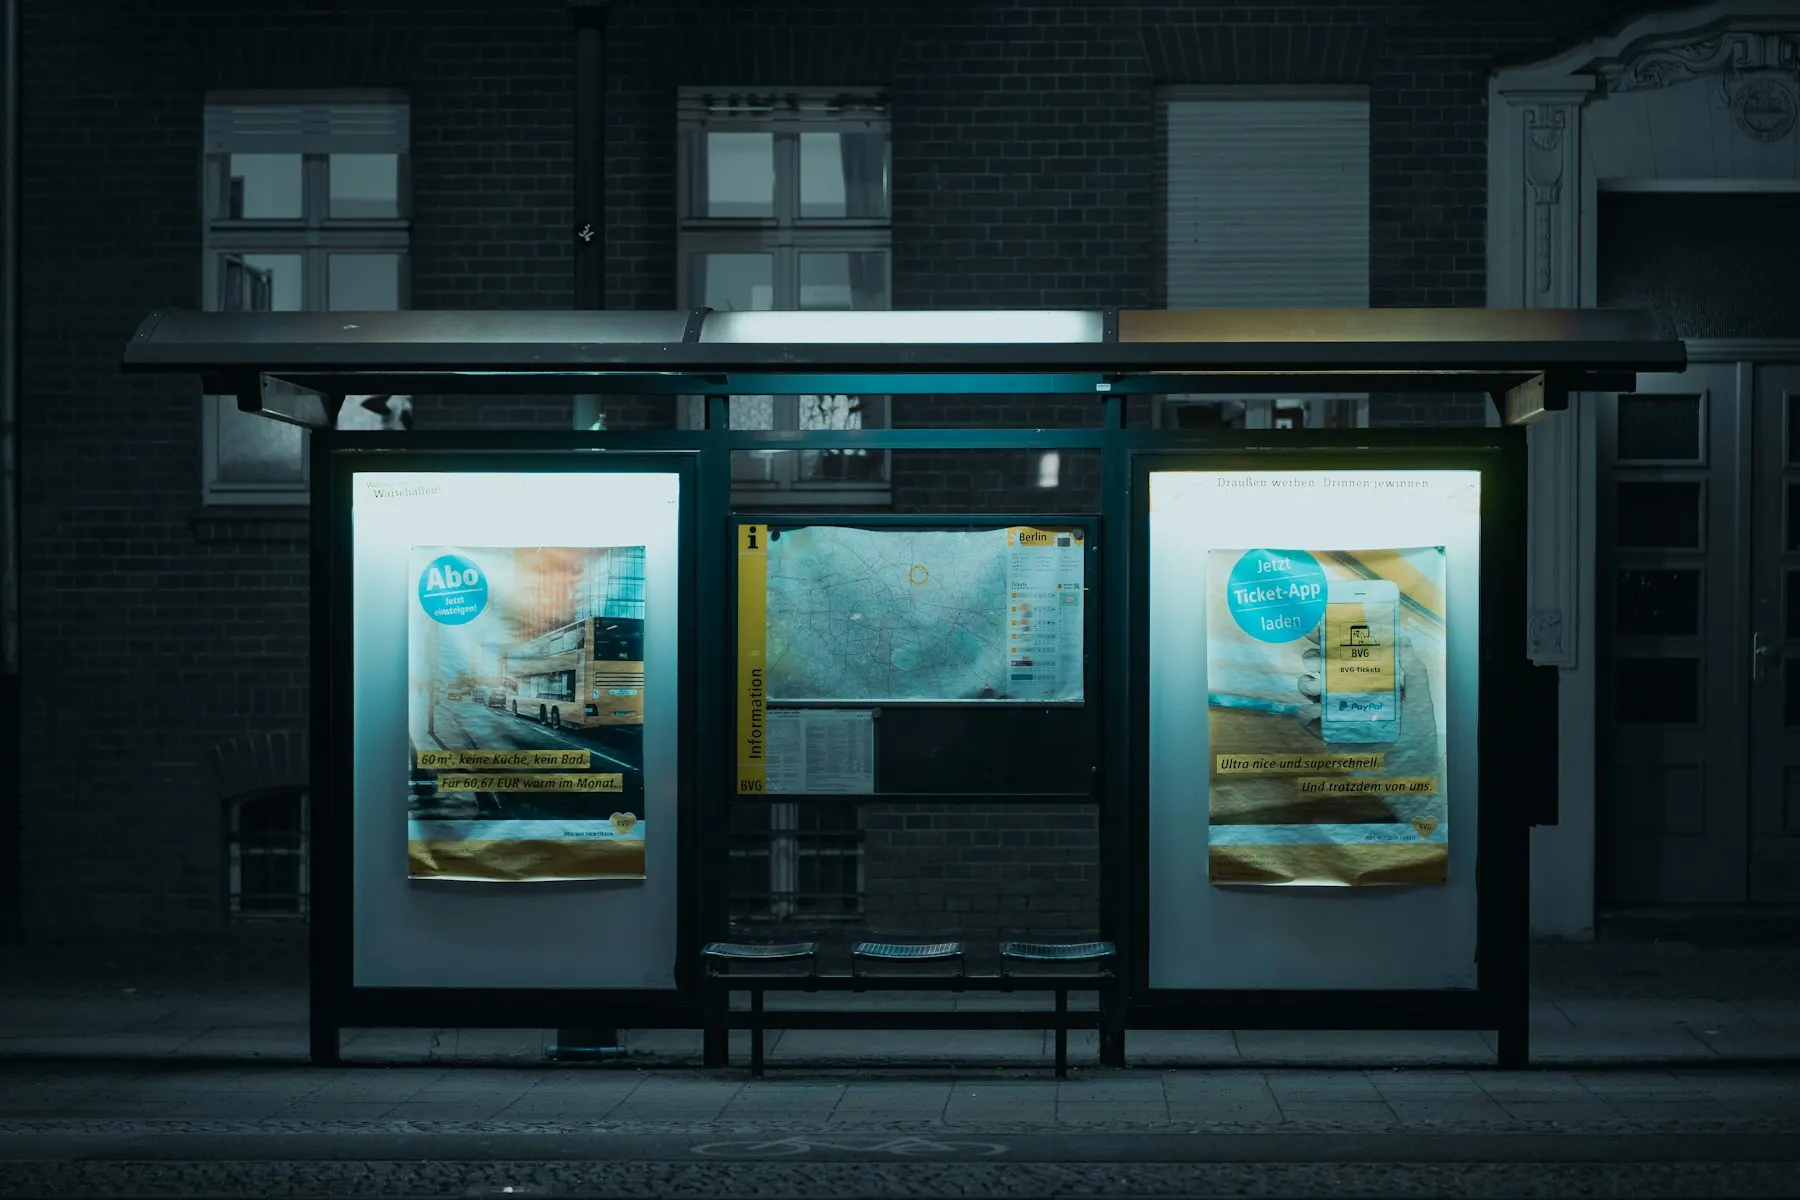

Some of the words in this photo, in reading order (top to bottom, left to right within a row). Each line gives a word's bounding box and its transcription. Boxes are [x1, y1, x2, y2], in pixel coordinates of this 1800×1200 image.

[1217, 477, 1267, 488] Draußen
[1323, 477, 1370, 488] Drinnen
[1019, 531, 1047, 542] Berlin
[1257, 556, 1292, 574] Jetzt
[426, 564, 479, 591] Abo
[444, 595, 465, 605] Jetzt
[1233, 582, 1321, 605] Ticket-App
[433, 603, 477, 616] einsteigen!
[1261, 614, 1301, 631] laden
[1351, 648, 1370, 658] BVG
[747, 668, 762, 759] Information
[1351, 702, 1383, 712] PayPal
[459, 753, 489, 765] keine
[493, 753, 530, 766] Küche,
[534, 753, 557, 765] kein
[561, 754, 586, 765] Bad.
[1221, 758, 1249, 769] Ultra
[1252, 758, 1276, 769] nice
[1279, 757, 1302, 769] und
[1303, 756, 1380, 770] superschnell.
[441, 777, 460, 788] Für
[463, 777, 494, 790] 60,67
[497, 778, 520, 788] EUR
[523, 779, 555, 788] warm
[559, 777, 573, 788] im
[576, 778, 617, 788] Monat.
[741, 779, 762, 791] BVG
[1302, 781, 1326, 792] Und
[1329, 781, 1381, 792] trotzdem
[1385, 783, 1406, 792] von
[1409, 782, 1433, 792] uns.
